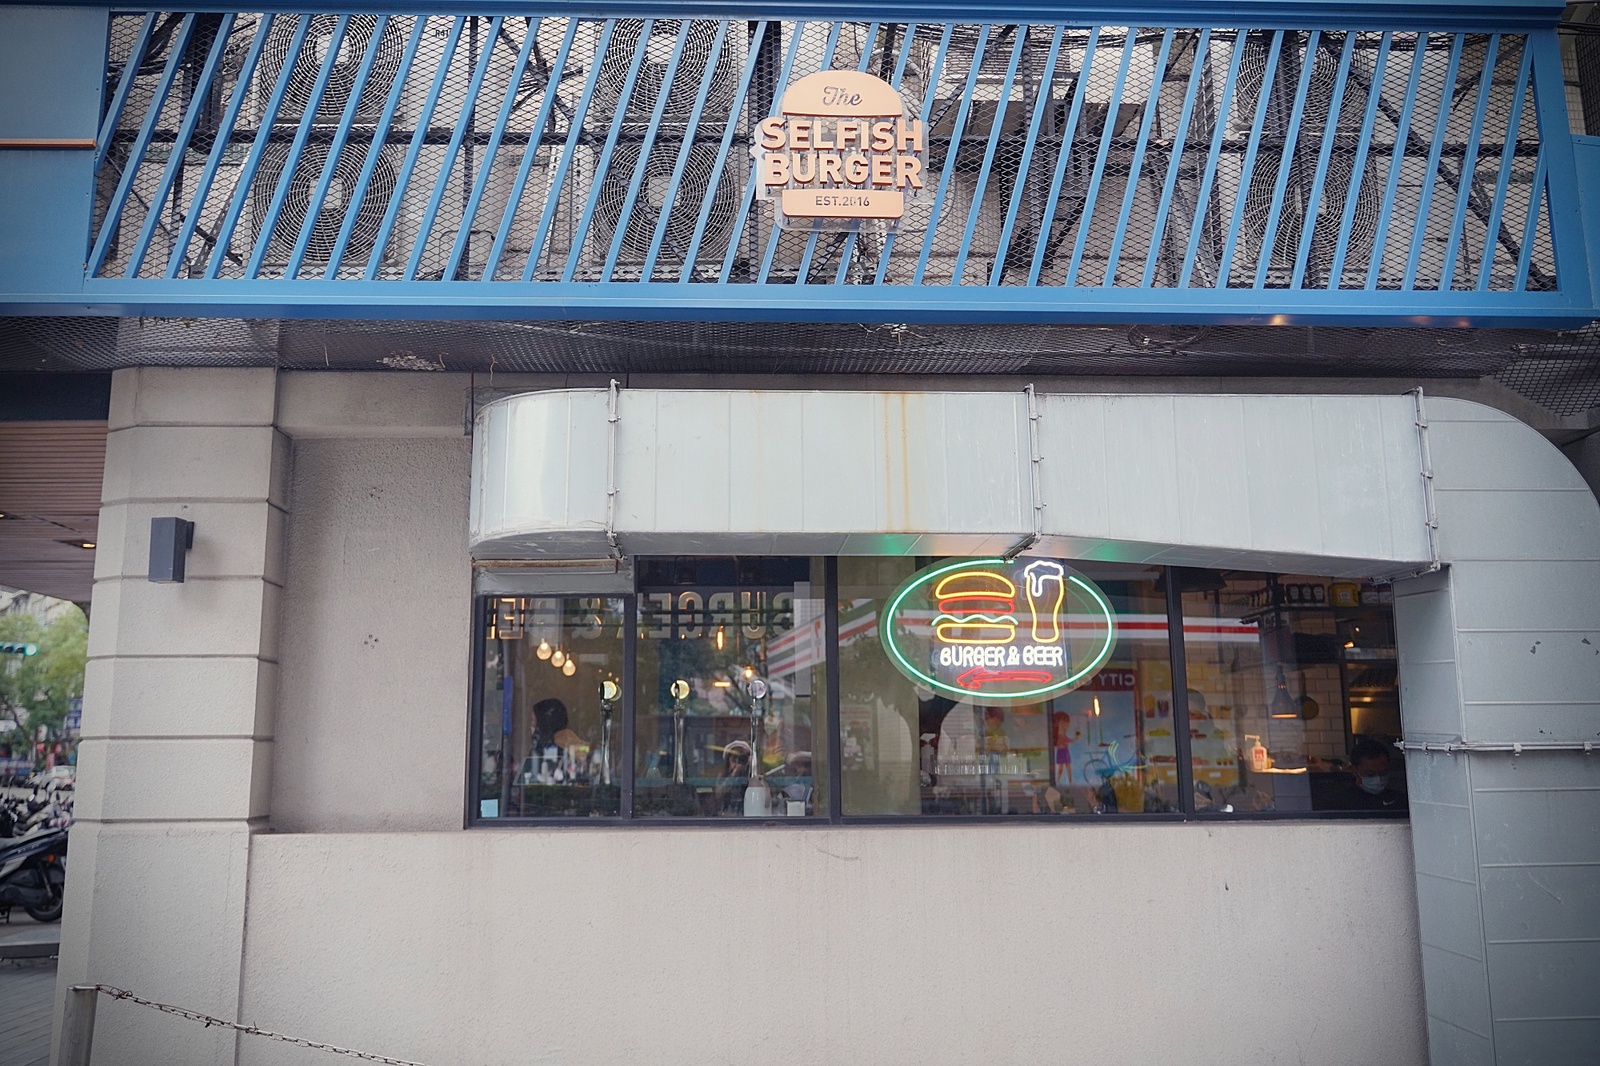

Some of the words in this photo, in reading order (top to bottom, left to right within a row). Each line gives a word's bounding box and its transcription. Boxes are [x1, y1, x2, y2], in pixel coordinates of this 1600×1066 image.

[822, 85, 863, 106] The
[760, 116, 923, 153] SELFISH
[765, 152, 923, 189] BURGER
[815, 195, 870, 207] EST.2016
[940, 644, 1006, 667] BURGER
[1022, 644, 1063, 667] BEER
